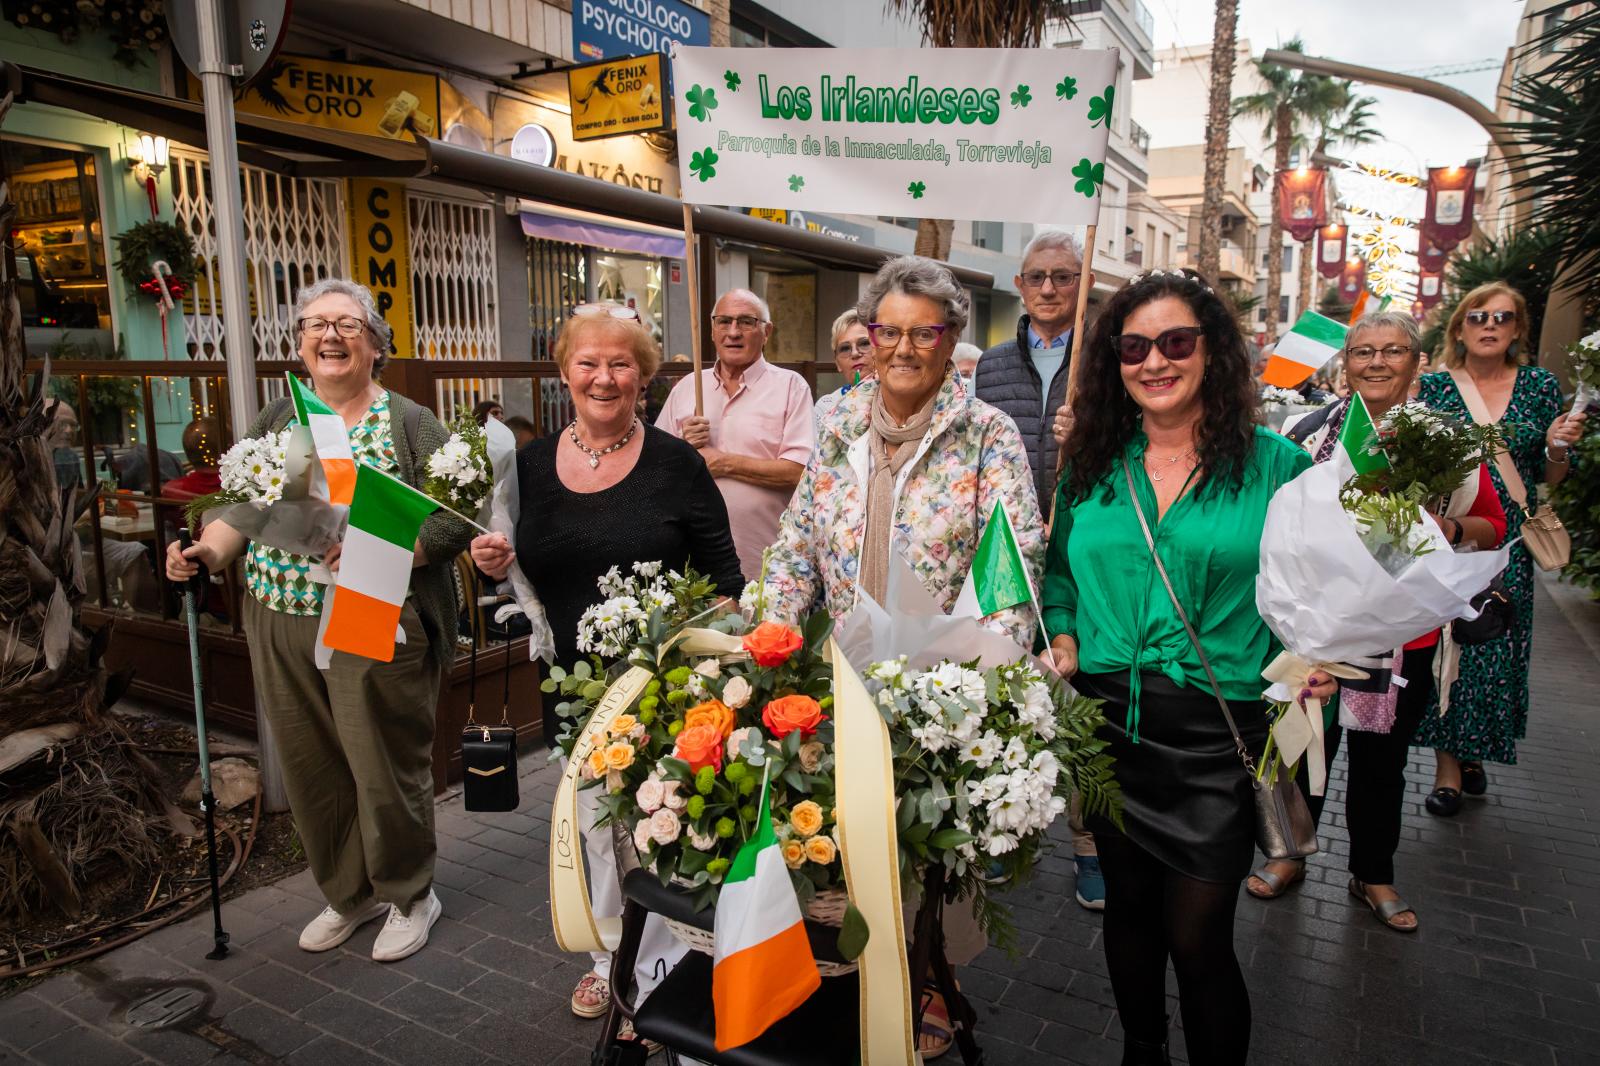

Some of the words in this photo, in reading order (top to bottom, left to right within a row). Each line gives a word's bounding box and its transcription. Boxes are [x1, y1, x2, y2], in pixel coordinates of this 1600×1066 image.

[288, 67, 375, 98] FENIX
[609, 65, 647, 81] FENIX
[616, 79, 642, 94] ORO
[304, 94, 362, 118] ORO
[758, 73, 812, 121] Los
[820, 74, 1000, 125] Irlandeses
[576, 121, 602, 131] COMPRO
[603, 119, 617, 127] ORO
[622, 116, 640, 124] CASH
[641, 113, 659, 121] GOLD
[717, 130, 797, 159] Parroquia
[801, 135, 821, 156] de
[824, 136, 841, 157] la
[844, 137, 950, 166] Inmaculada,
[956, 139, 1052, 169] Torrevieja
[556, 818, 574, 870] LOS
